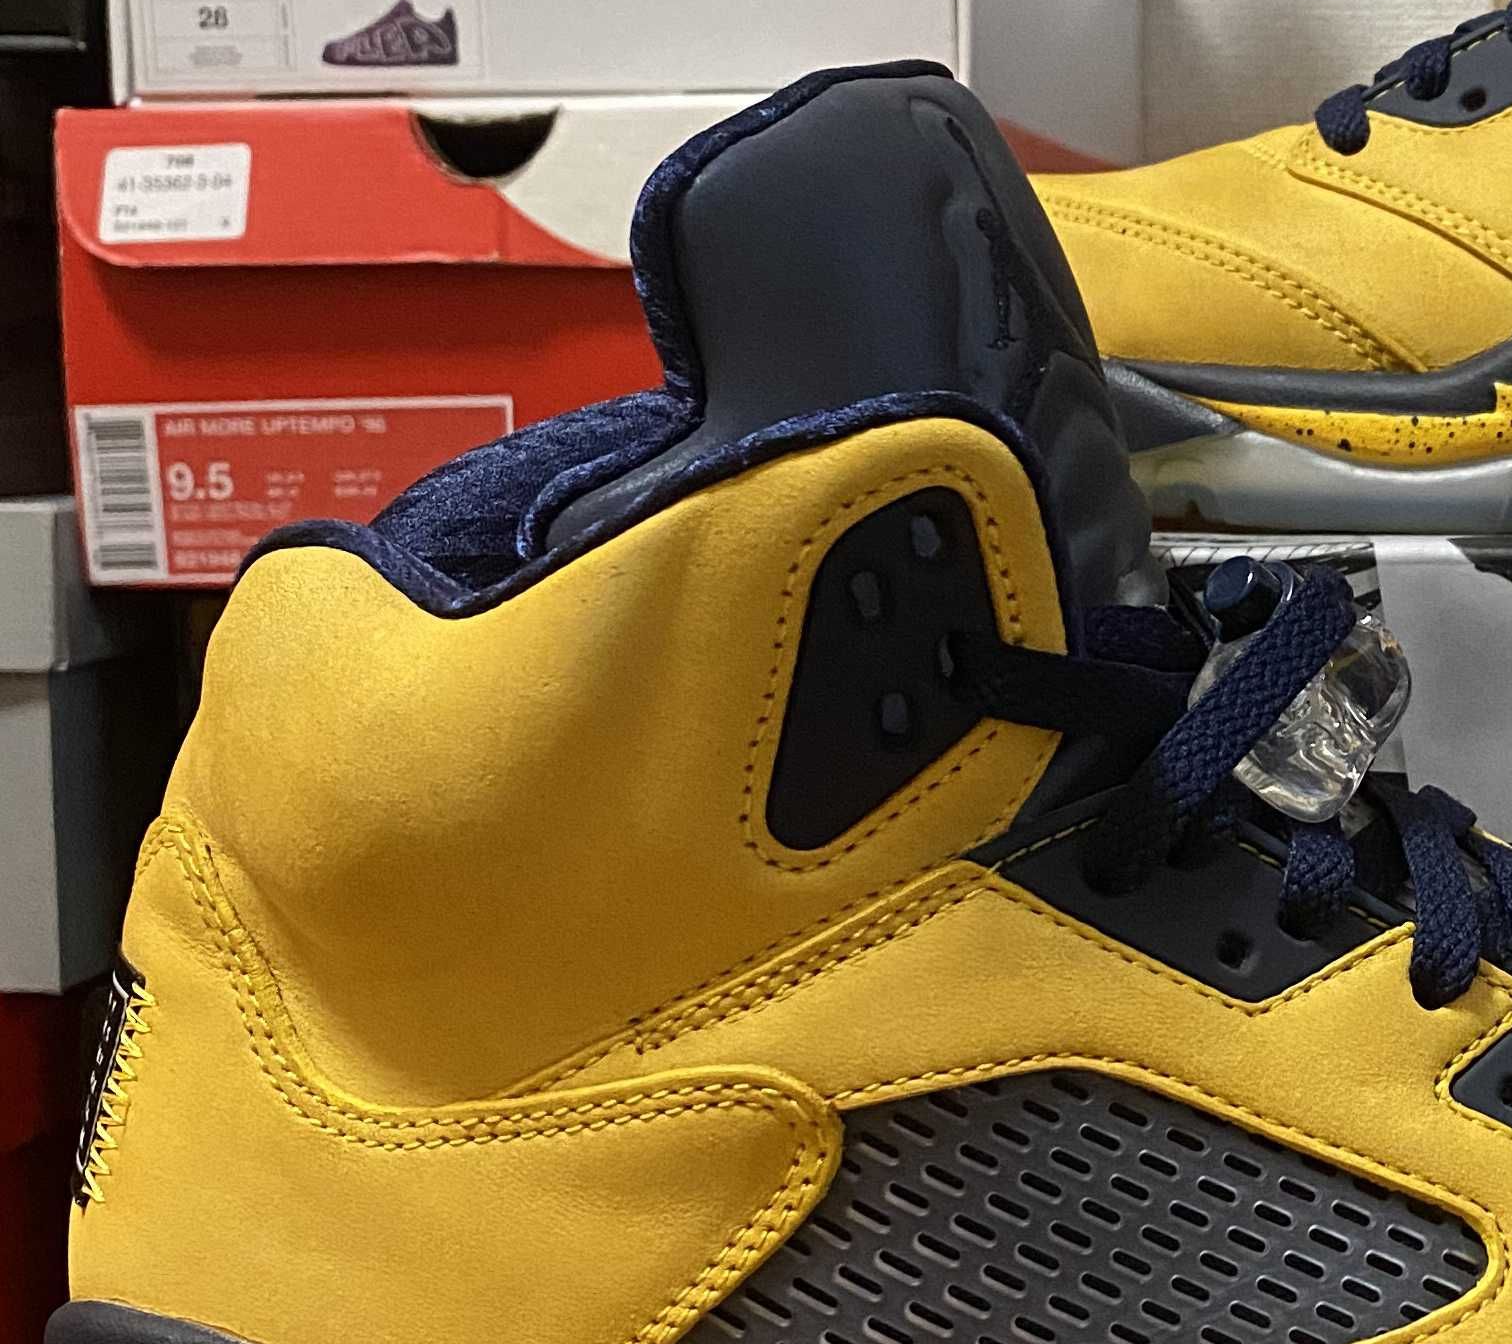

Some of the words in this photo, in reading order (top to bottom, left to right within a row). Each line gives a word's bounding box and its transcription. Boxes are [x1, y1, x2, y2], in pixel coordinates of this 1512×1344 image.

[164, 417, 196, 437] AIR
[200, 416, 255, 436] MORE
[260, 414, 356, 436] UPTEMPO
[167, 460, 235, 501] 9.5
